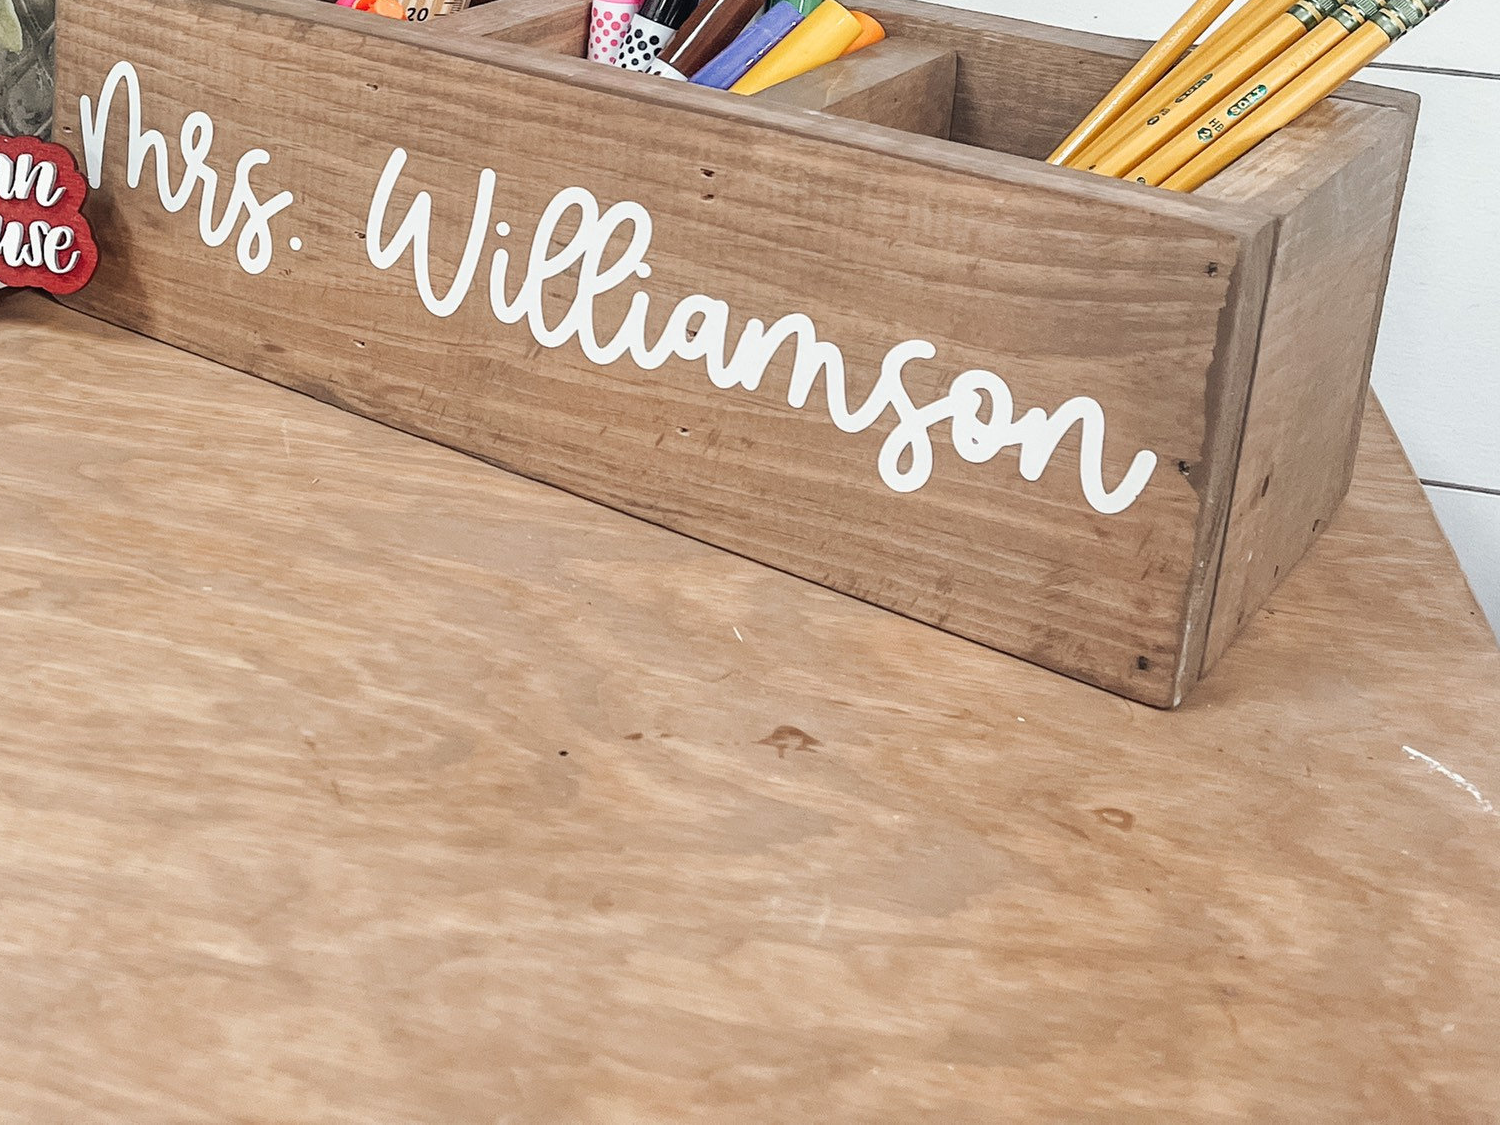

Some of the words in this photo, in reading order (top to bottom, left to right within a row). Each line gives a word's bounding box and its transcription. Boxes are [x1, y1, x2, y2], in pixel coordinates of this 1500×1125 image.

[406, 7, 429, 22] 20
[1228, 84, 1267, 117] SOFT
[1208, 117, 1225, 133] HB
[79, 61, 303, 275] Mrs.
[366, 146, 1158, 515] Williamson
